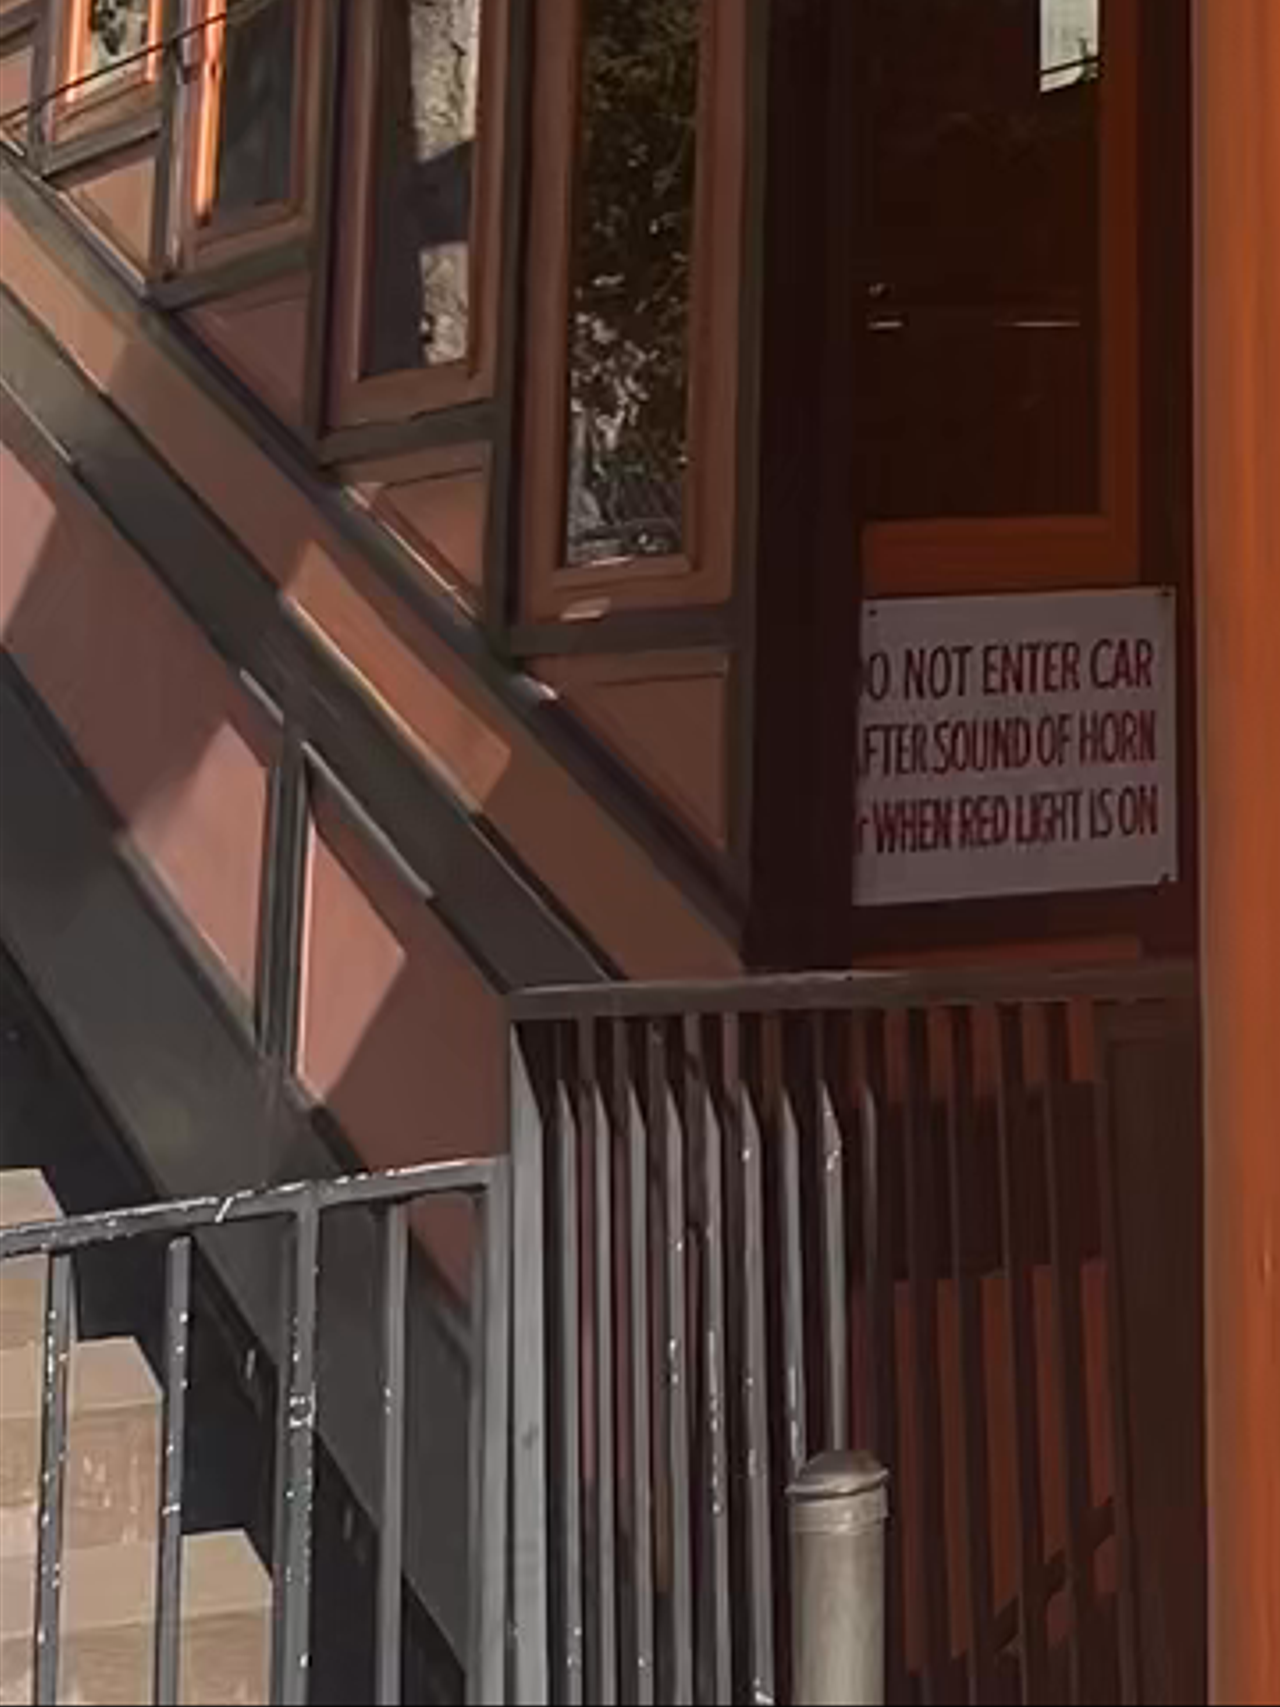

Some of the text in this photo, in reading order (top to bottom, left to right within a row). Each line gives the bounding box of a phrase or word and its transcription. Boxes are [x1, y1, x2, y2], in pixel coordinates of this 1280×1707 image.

[904, 645, 973, 701] NOT
[982, 641, 1081, 696] ENTER
[1089, 637, 1154, 689] CAR
[858, 709, 1157, 777] FTER SOUND OF HORN
[871, 799, 951, 855] WHEN
[958, 793, 1010, 849] RED
[1015, 789, 1082, 845] LIGHT
[1089, 787, 1115, 839] IS
[1117, 784, 1159, 837] ON
